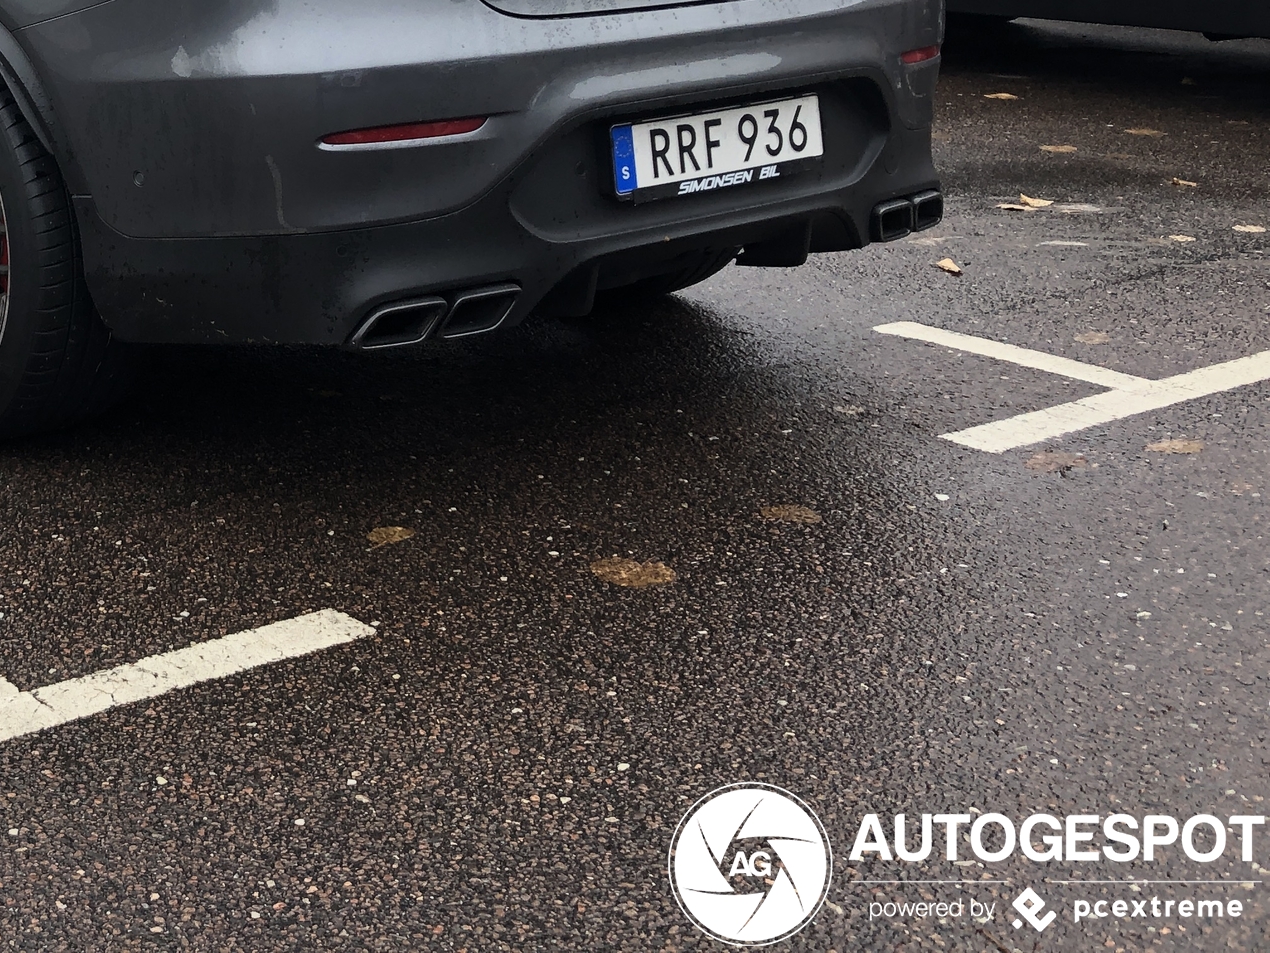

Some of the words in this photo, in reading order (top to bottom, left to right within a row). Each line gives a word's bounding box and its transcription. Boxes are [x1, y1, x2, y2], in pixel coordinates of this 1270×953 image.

[649, 117, 722, 179] RRF
[737, 104, 808, 163] 936
[621, 165, 631, 180] S
[677, 169, 754, 196] SIMONSEN
[758, 164, 781, 179] BIL
